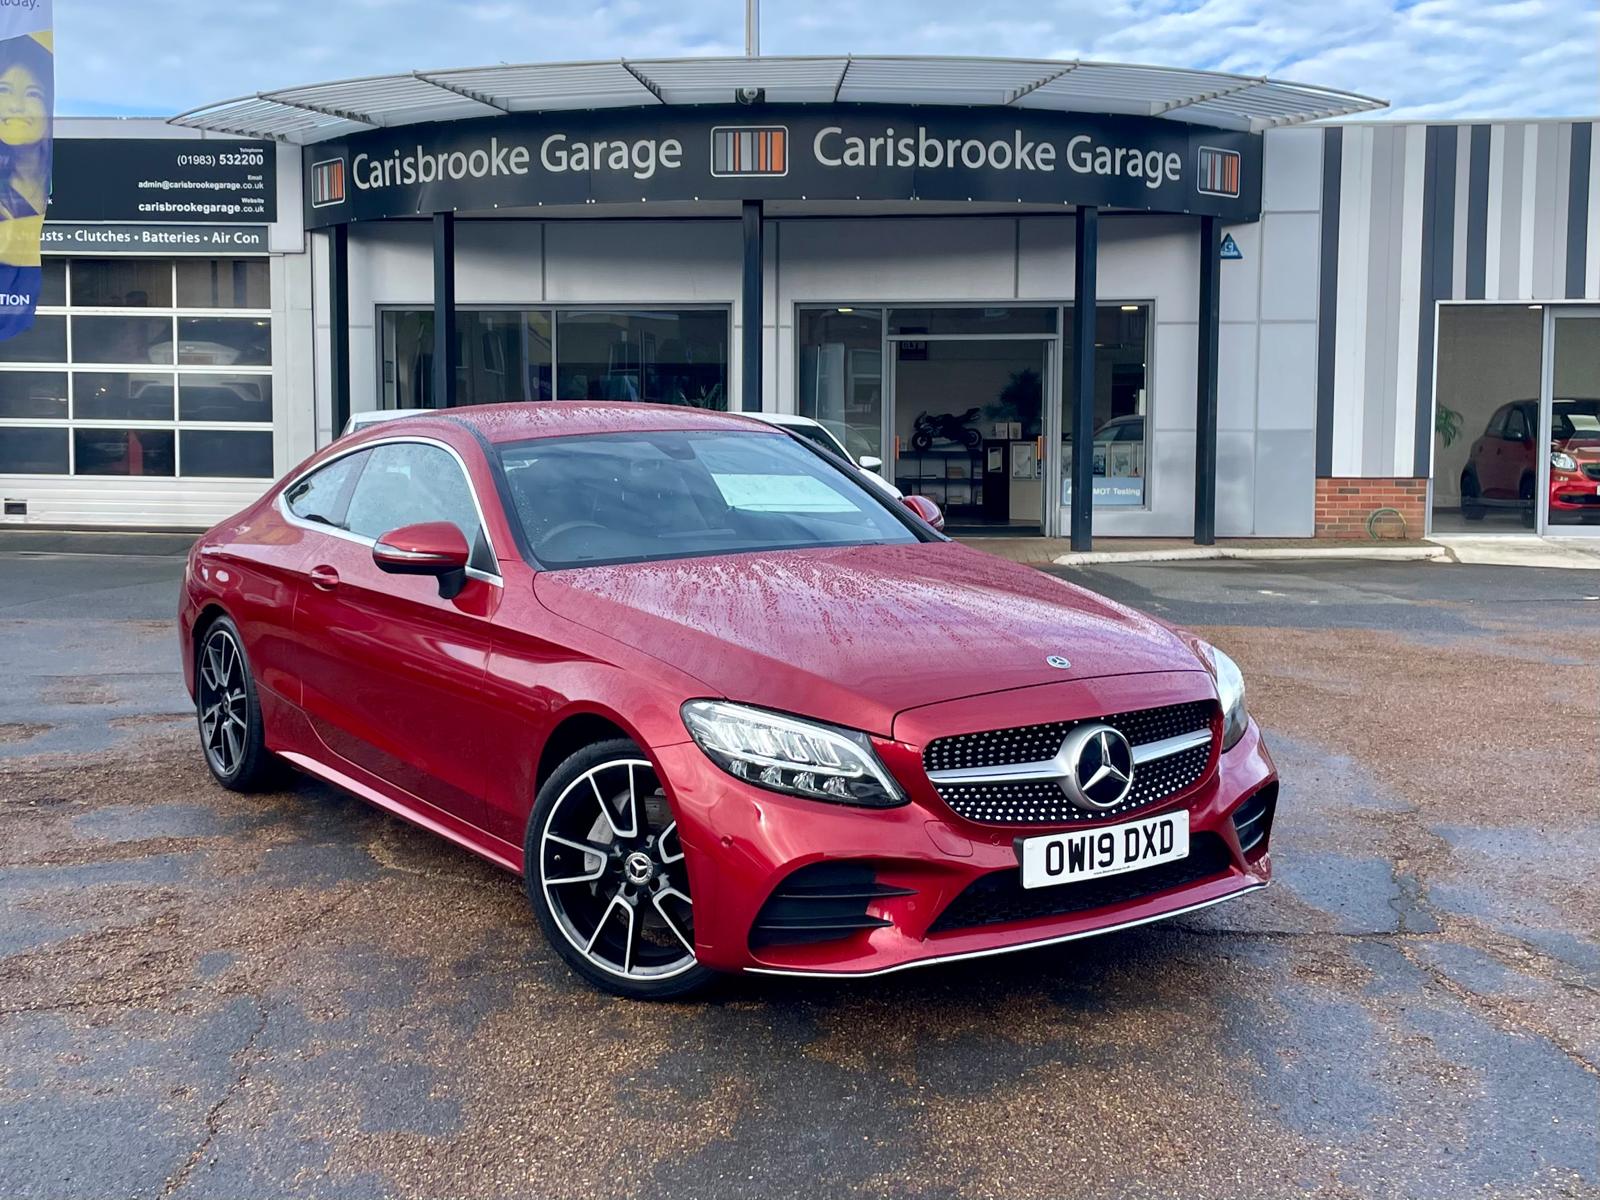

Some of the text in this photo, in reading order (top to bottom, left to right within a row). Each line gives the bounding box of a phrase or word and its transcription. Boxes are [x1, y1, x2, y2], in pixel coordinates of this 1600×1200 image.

[177, 154, 264, 167] (01983) 532200
[353, 134, 683, 190] Carisbrooke Garage
[813, 126, 1182, 189] Carisbrooke Garage
[138, 180, 264, 190] admin@carisbrookegarage.co.uk
[138, 202, 265, 214] carisbrookegarage.co.uk
[40, 230, 260, 243] usts Clutches Batteries Air Con
[1092, 487, 1140, 497] MOT Testing
[1045, 819, 1174, 876] OW19 DXD
